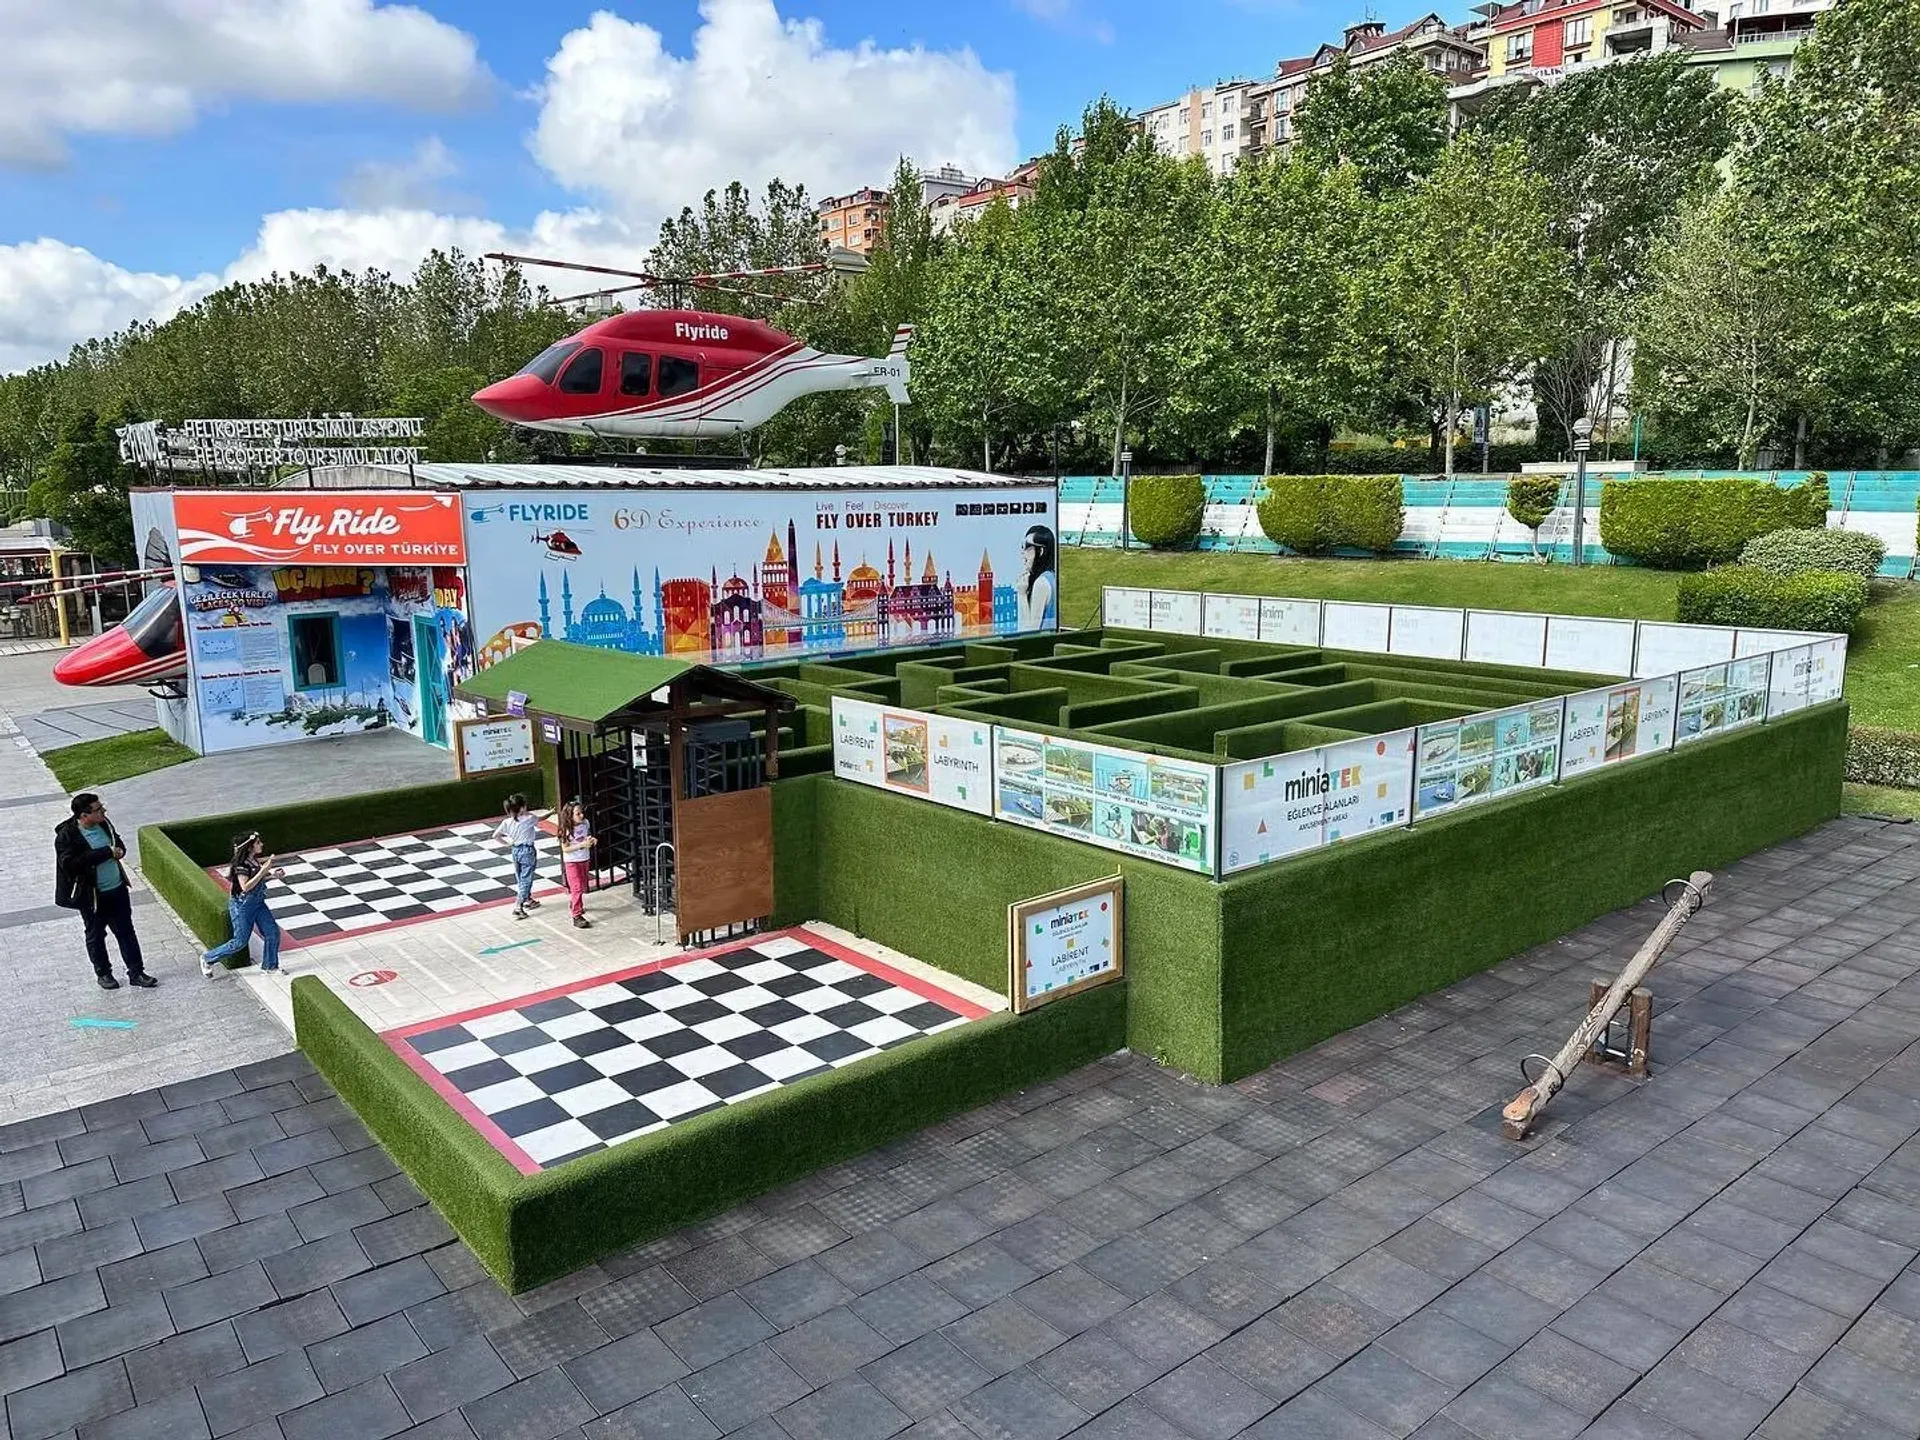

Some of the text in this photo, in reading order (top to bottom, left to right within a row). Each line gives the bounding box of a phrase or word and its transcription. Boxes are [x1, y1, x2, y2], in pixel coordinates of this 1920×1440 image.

[675, 322, 728, 341] Flyride
[873, 366, 900, 377] ER-01
[272, 419, 312, 438] TURU
[195, 447, 282, 464] HELICOPTER
[281, 447, 325, 464] TOUR
[327, 446, 419, 464] SIMULATION
[509, 504, 589, 521] FLYRIDE
[816, 501, 909, 511] Live Feel Discover
[272, 507, 401, 545] Fly Ride
[613, 508, 763, 535] 6D Experience
[816, 511, 939, 529] FLY OVER TURKEY
[313, 541, 459, 555] FLY OVER TÜRKİYE
[194, 599, 231, 612] PLACES
[933, 753, 979, 773] LABYRINTH
[1284, 764, 1362, 802] miniaTEK
[1287, 793, 1360, 821] EĞLENCE ALANLARI
